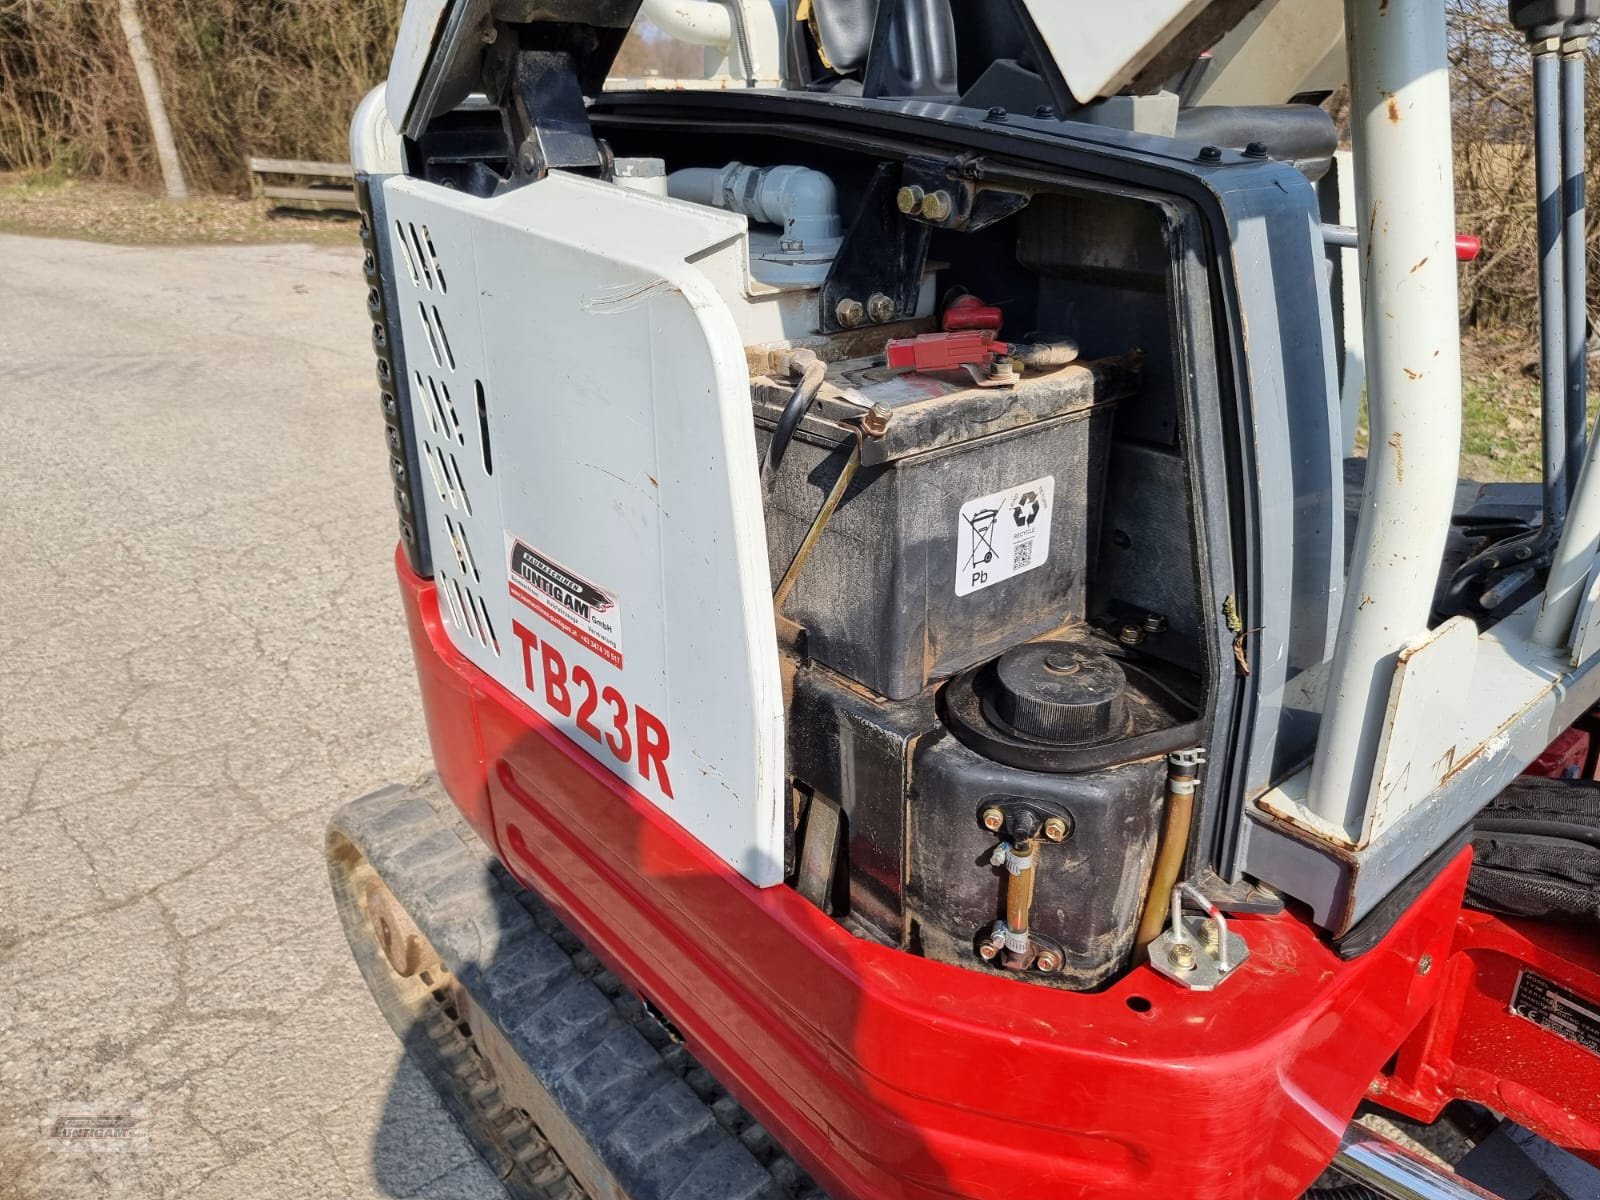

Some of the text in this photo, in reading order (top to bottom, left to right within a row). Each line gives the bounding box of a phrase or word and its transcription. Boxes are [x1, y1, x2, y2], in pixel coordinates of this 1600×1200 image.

[1013, 527, 1036, 539] RECYCLE
[524, 553, 580, 592] BAUMASCHINEN
[971, 570, 988, 587] Pb
[591, 615, 612, 633] GmbH
[512, 618, 675, 801] TB23R
